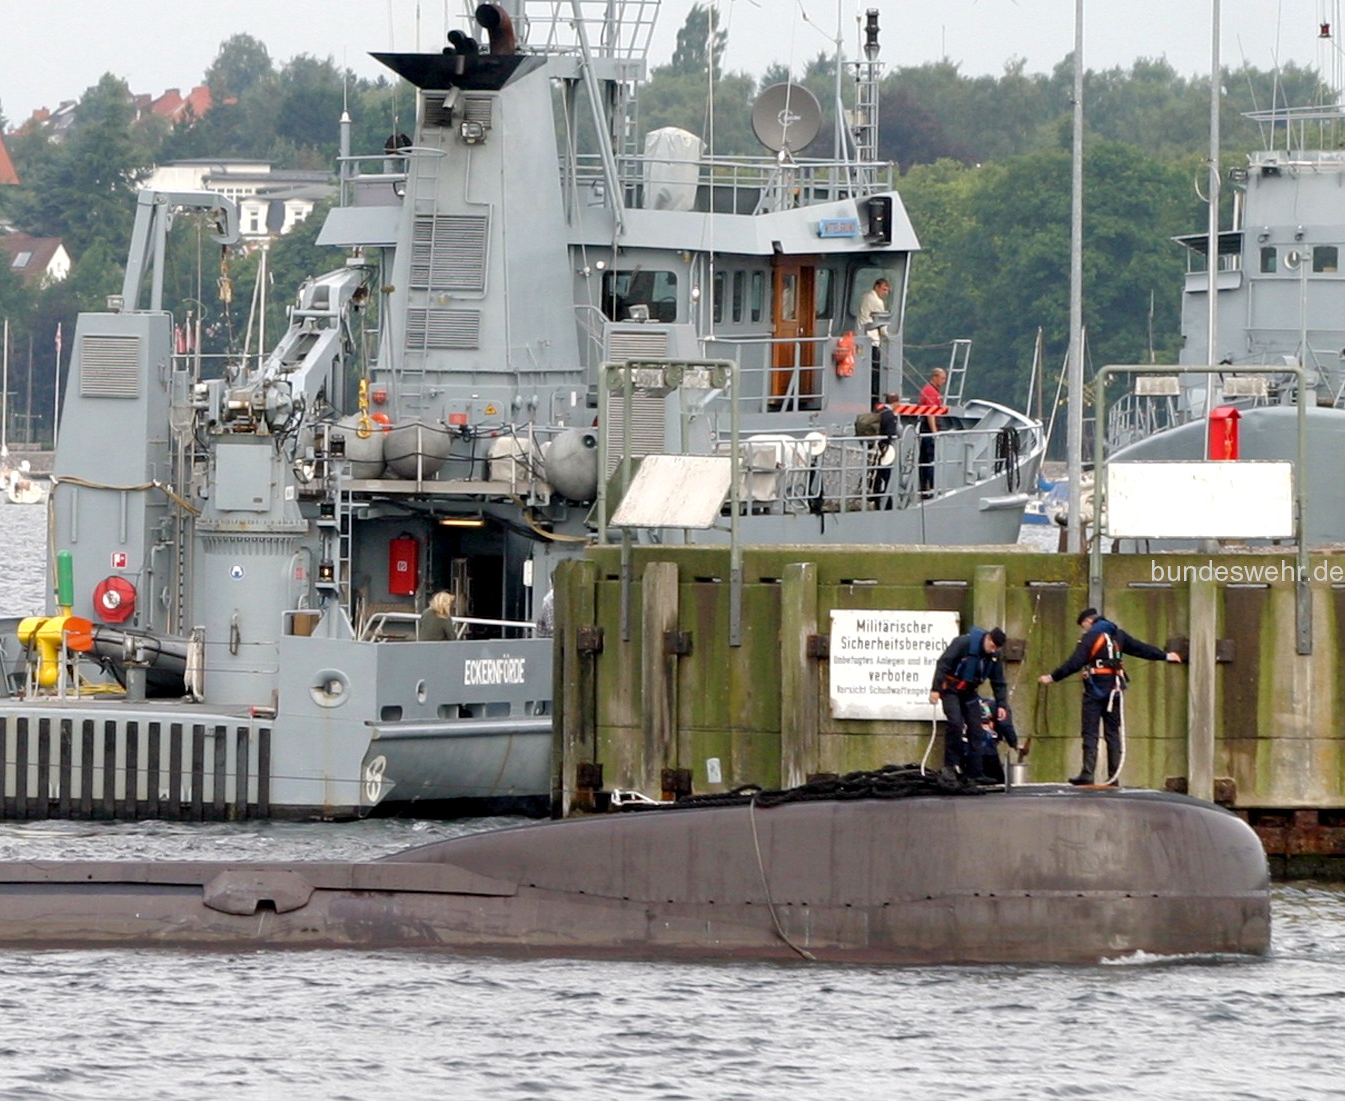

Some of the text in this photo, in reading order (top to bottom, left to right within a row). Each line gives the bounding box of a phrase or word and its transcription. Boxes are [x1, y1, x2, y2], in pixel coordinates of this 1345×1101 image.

[856, 619, 934, 634] Militärischer
[841, 636, 948, 651] Sicherheitsbereich
[464, 654, 525, 685] ECKERNFÖRDE
[869, 668, 919, 682] verboten
